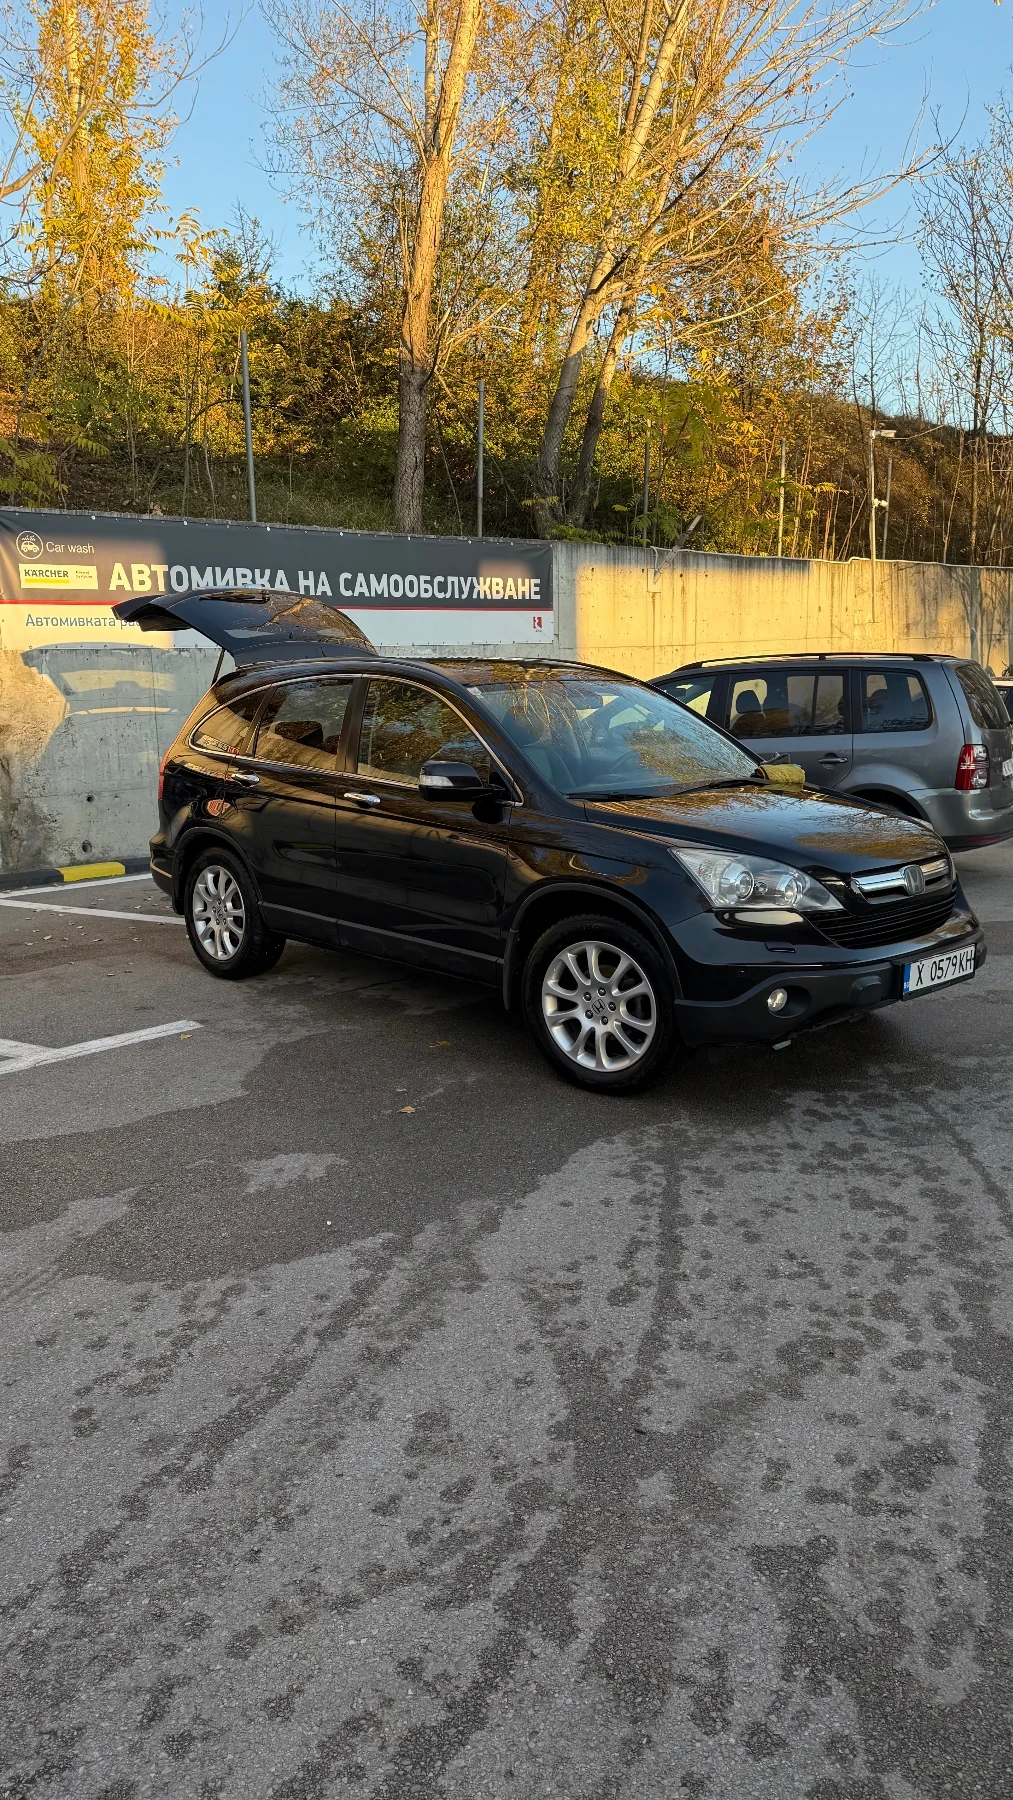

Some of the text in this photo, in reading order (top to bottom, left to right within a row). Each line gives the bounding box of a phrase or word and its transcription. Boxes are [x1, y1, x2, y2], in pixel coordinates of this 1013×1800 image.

[46, 542, 95, 554] Car wash
[24, 569, 69, 578] KÄRCHER
[109, 562, 541, 600] АВТОМИВКА НА САМООБСЛУЖВАНЕ
[26, 613, 116, 627] Автомивката
